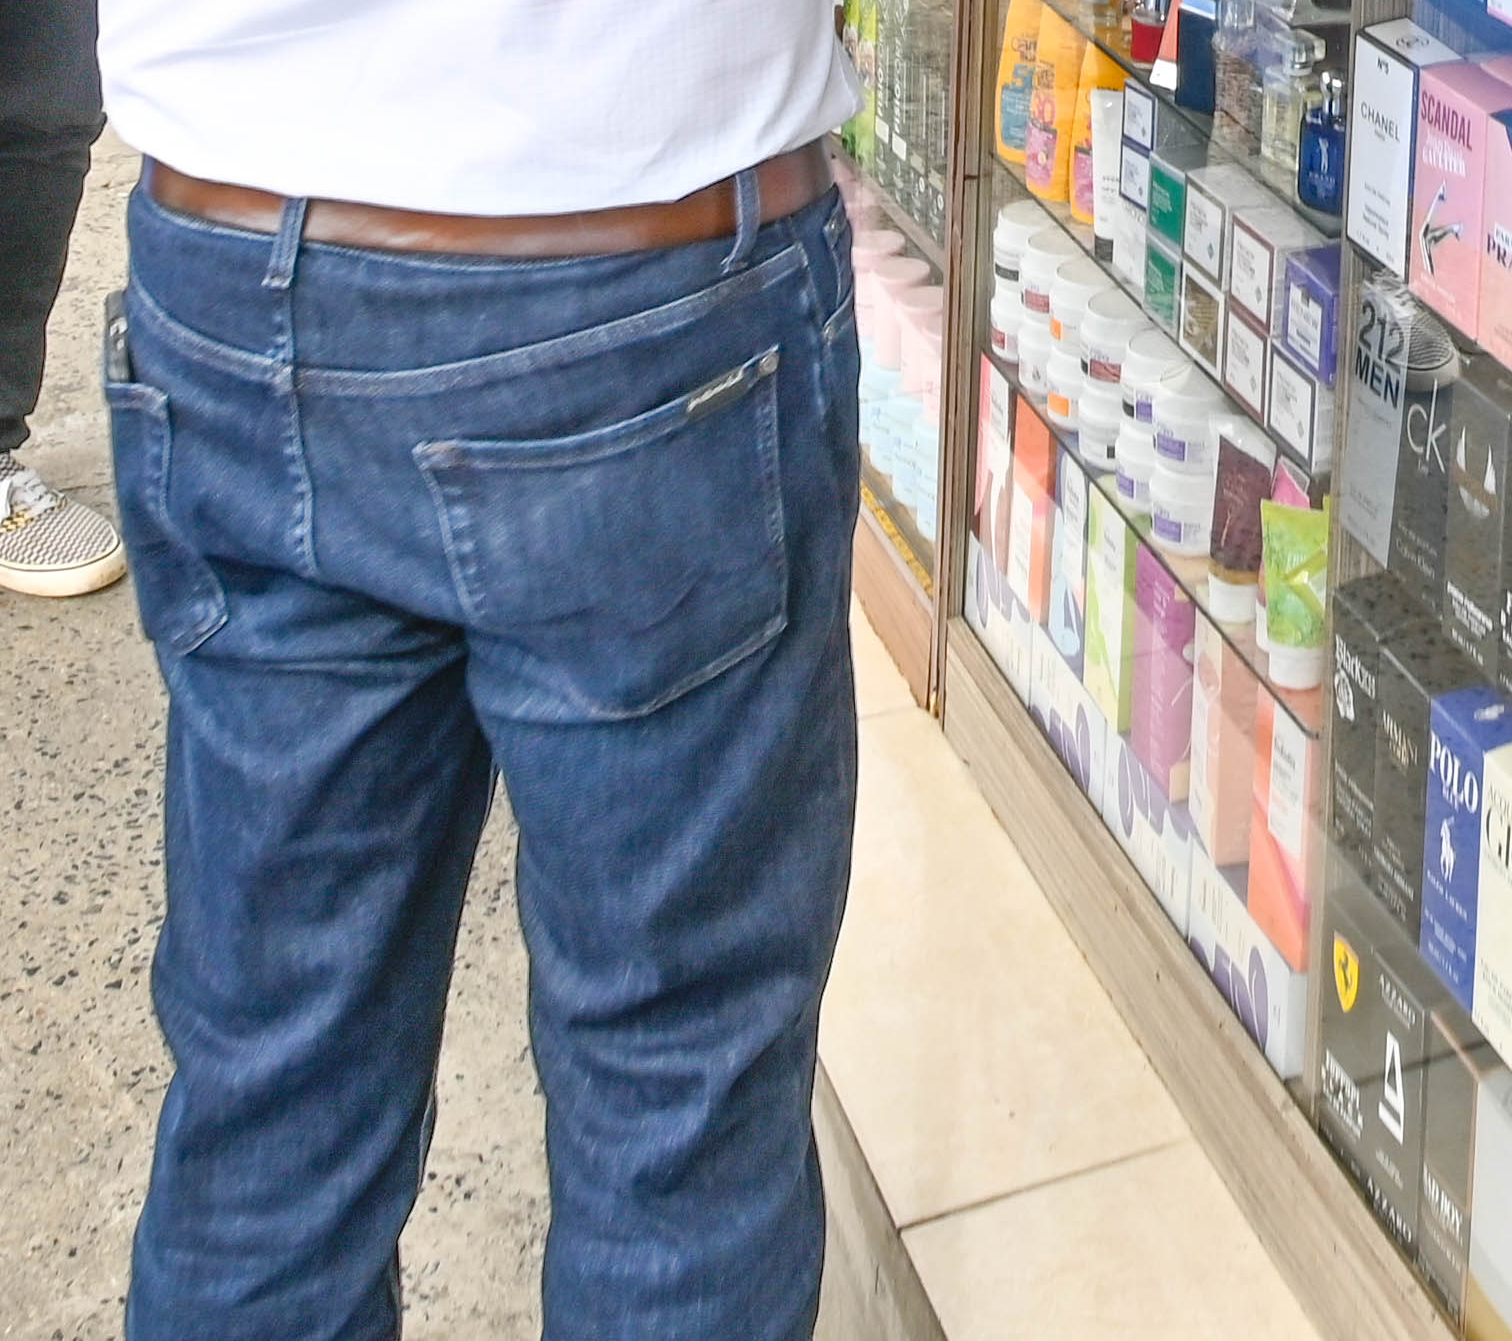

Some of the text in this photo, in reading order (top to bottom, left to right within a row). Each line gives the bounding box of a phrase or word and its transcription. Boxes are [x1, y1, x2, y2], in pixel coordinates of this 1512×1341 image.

[1360, 102, 1400, 143] CHANEL
[1421, 91, 1472, 153] SCANDAL
[1359, 300, 1405, 373] 212
[1355, 349, 1401, 410] MEN
[1406, 378, 1446, 474] ck
[1429, 730, 1479, 815] POLO
